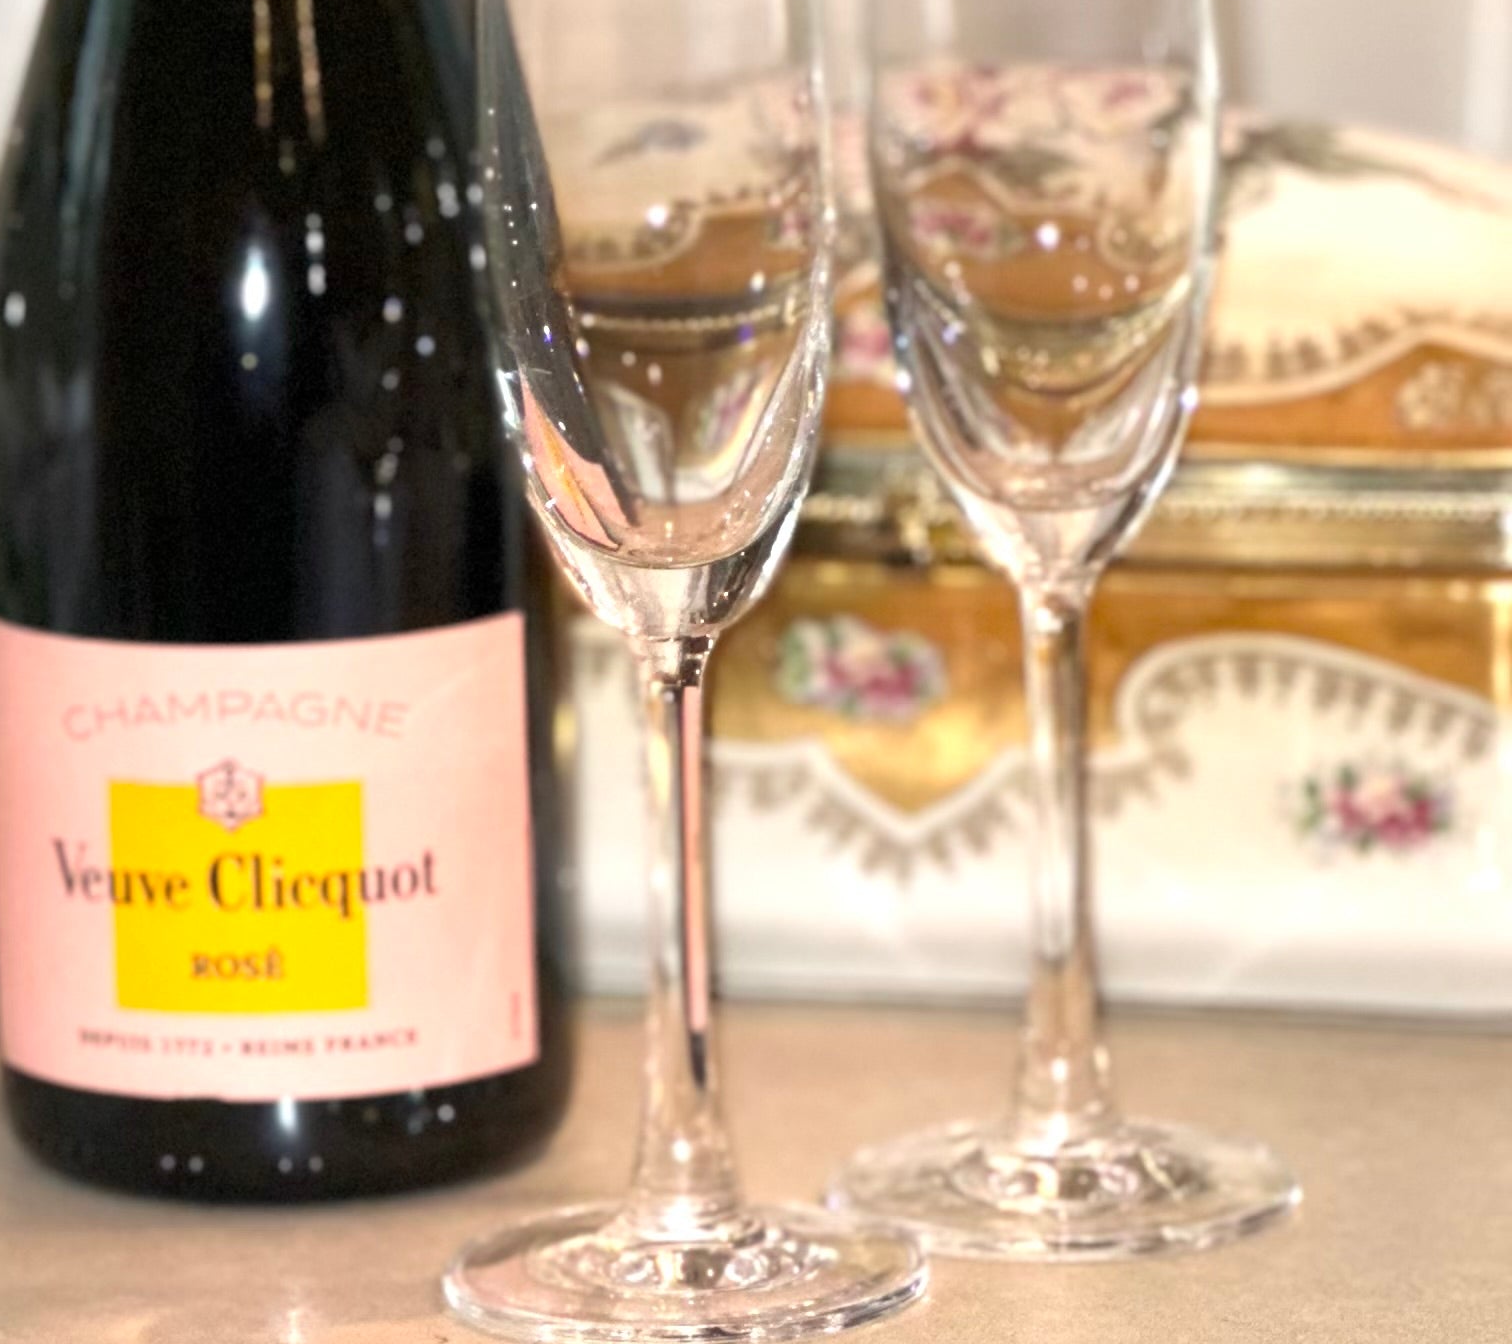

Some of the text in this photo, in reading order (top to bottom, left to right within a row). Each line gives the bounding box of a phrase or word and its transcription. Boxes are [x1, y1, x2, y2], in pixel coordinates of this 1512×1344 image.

[62, 689, 411, 743] CHAMPAGNE
[51, 837, 439, 921] Veuve Clicquot
[190, 946, 286, 981] ROSÉ
[325, 1027, 420, 1055] FRANCE
